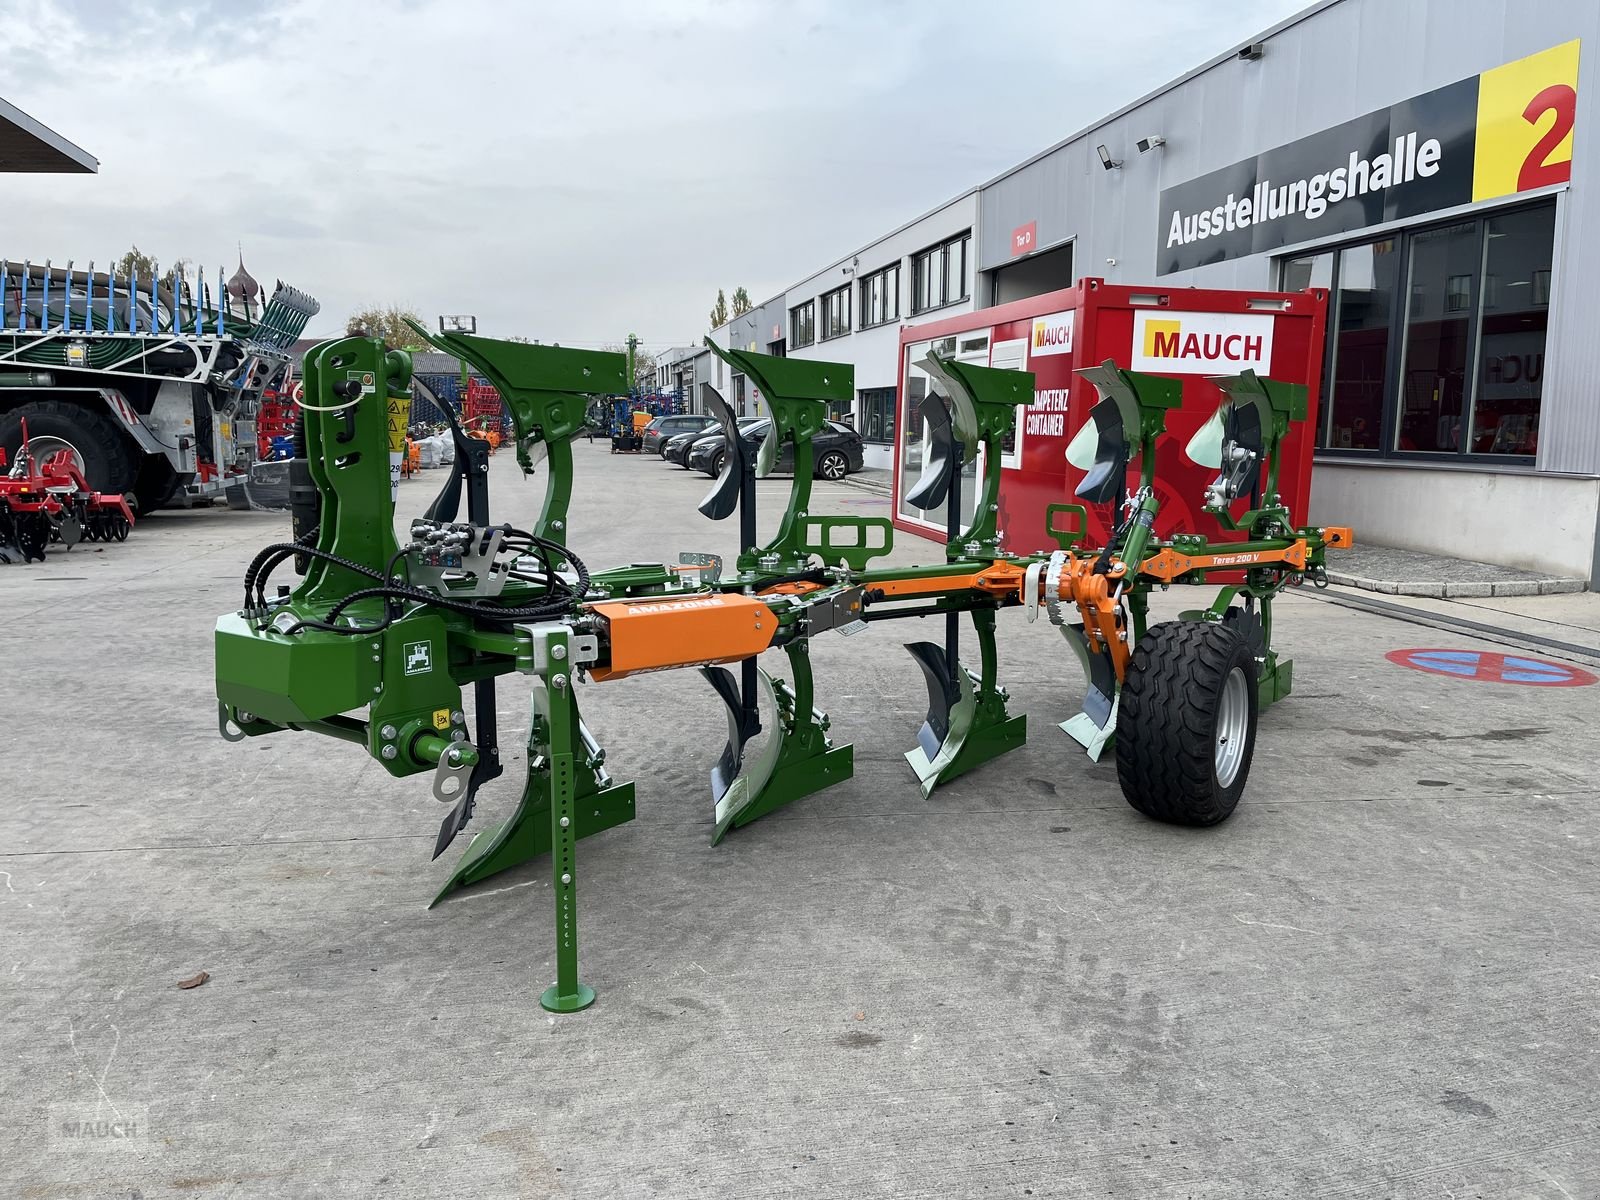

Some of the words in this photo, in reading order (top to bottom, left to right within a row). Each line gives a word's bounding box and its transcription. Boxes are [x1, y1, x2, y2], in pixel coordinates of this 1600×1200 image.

[1166, 131, 1442, 249] Ausstellungshalle
[1516, 83, 1577, 193] 2
[1036, 325, 1070, 348] MAUCH
[1153, 331, 1263, 361] MAUCH
[1027, 388, 1069, 412] OMPETENZ
[1026, 414, 1064, 437] CONTAINER
[691, 553, 697, 564] 2
[700, 554, 706, 565] 3
[1213, 556, 1235, 565] Teres
[1236, 554, 1252, 563] 200
[1253, 553, 1260, 561] V
[628, 599, 725, 615] AMAZONE
